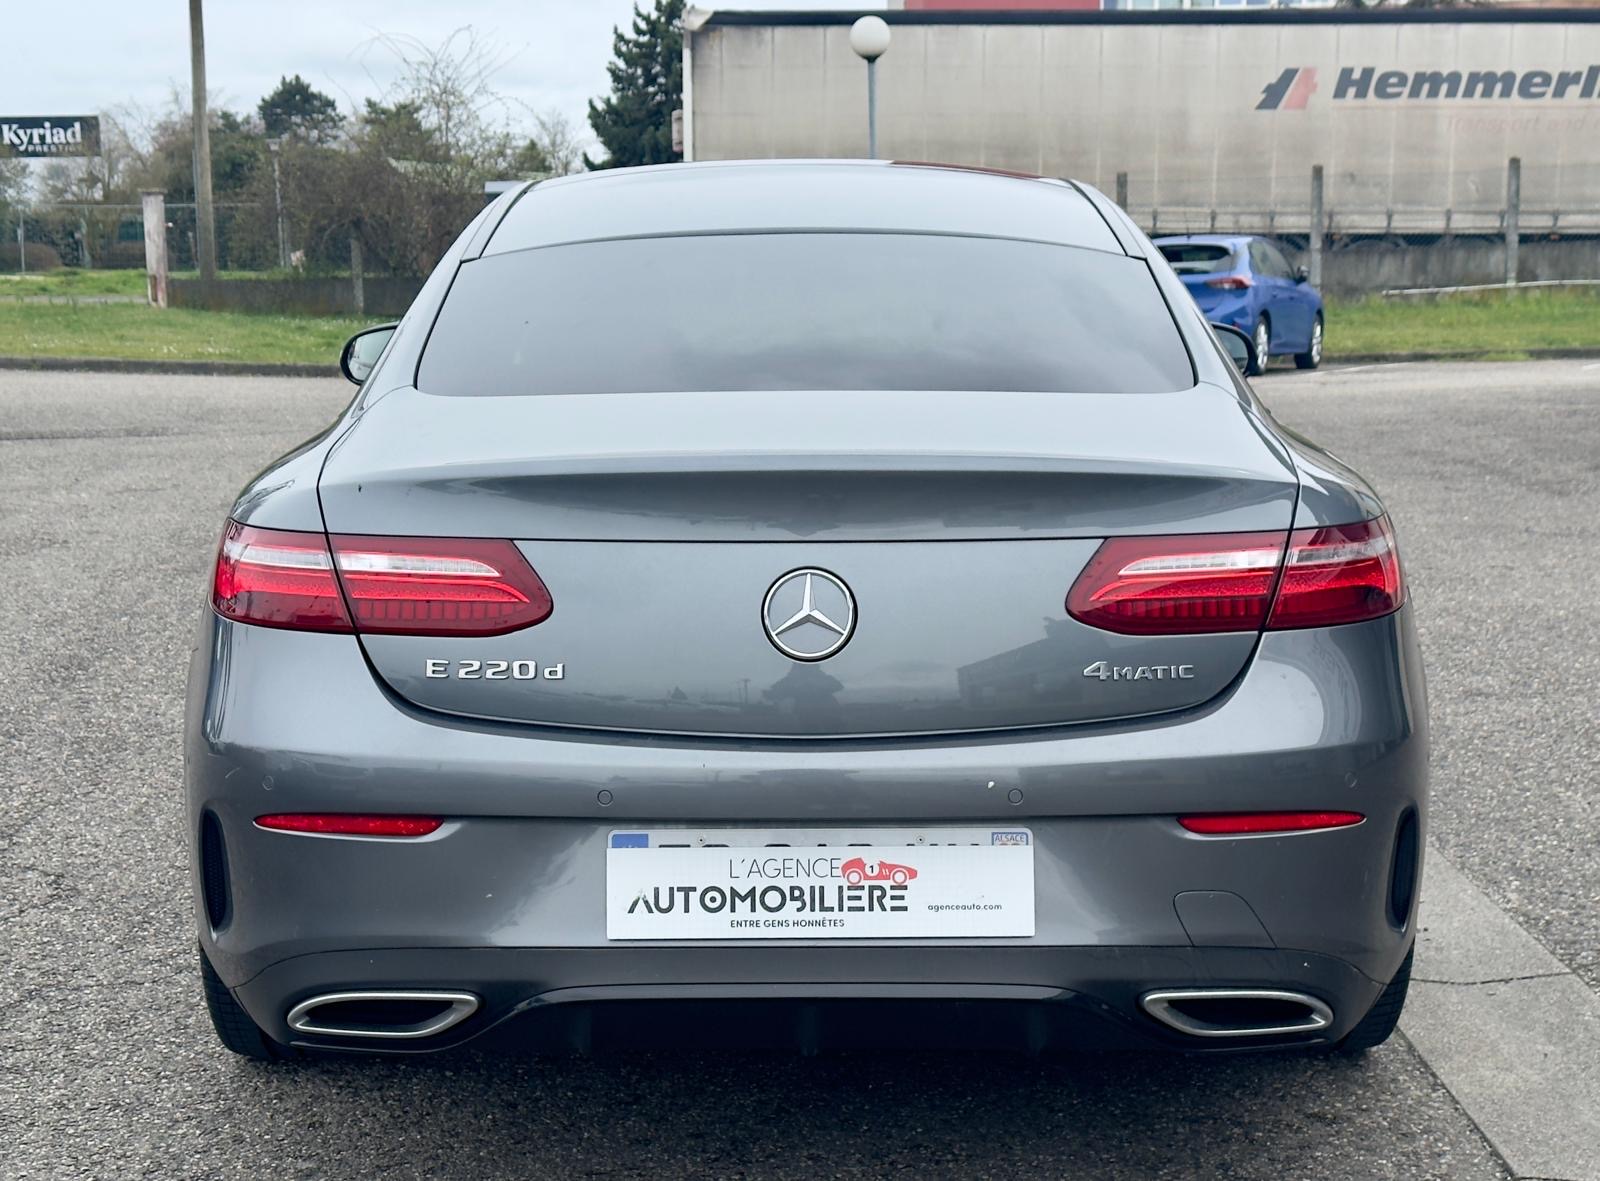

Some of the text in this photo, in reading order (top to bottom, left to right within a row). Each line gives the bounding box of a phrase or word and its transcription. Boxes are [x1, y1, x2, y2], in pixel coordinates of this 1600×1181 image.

[1332, 64, 1600, 100] Hemmerl
[1, 121, 82, 152] Kyriad
[425, 659, 450, 678] E
[1083, 661, 1195, 680] 4MATIC
[995, 834, 1025, 842] ALSACE
[729, 858, 841, 878] L'AGENCE
[927, 903, 1003, 912] agenceauto.com
[730, 917, 845, 928] ENTRE GENS HONNÊTES
